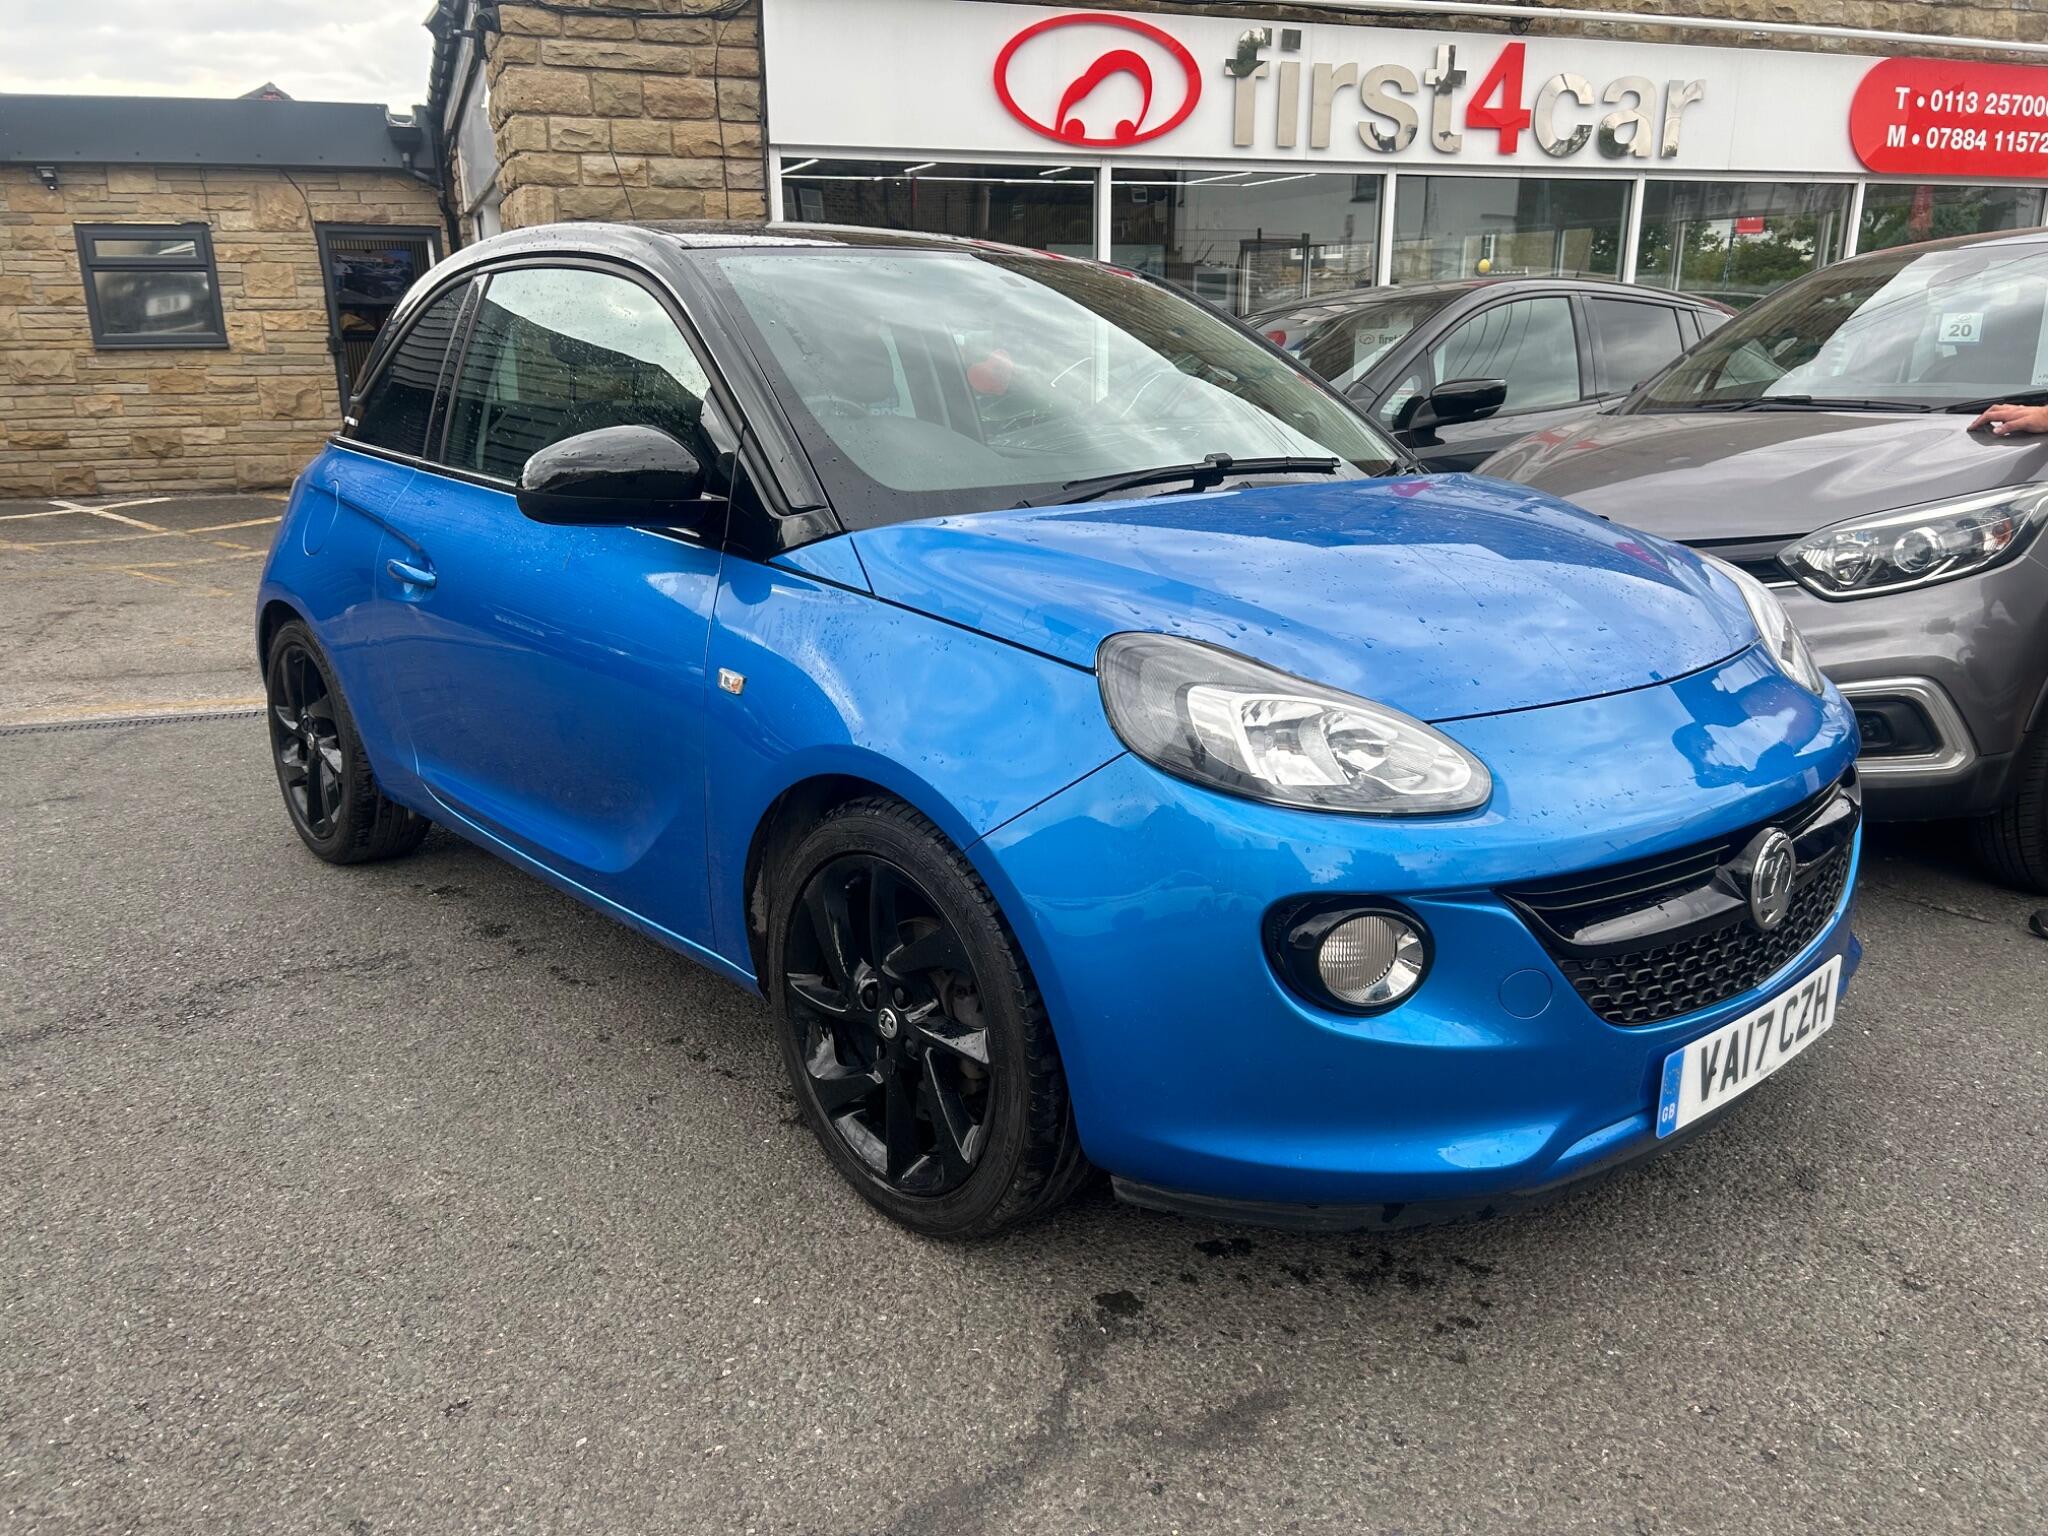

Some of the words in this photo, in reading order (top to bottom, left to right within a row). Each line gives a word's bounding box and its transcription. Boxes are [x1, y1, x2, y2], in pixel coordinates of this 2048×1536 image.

[1224, 27, 1707, 159] first4car
[1895, 87, 1910, 110] T
[1930, 89, 1979, 114] 0113
[1984, 93, 2048, 117] 25700
[1886, 125, 1907, 148] M
[1926, 127, 1987, 151] 07884
[1948, 324, 1972, 337] 20
[1701, 1008, 1775, 1102] VA17
[1778, 968, 1832, 1053] CZH
[1662, 1102, 1675, 1122] GB
